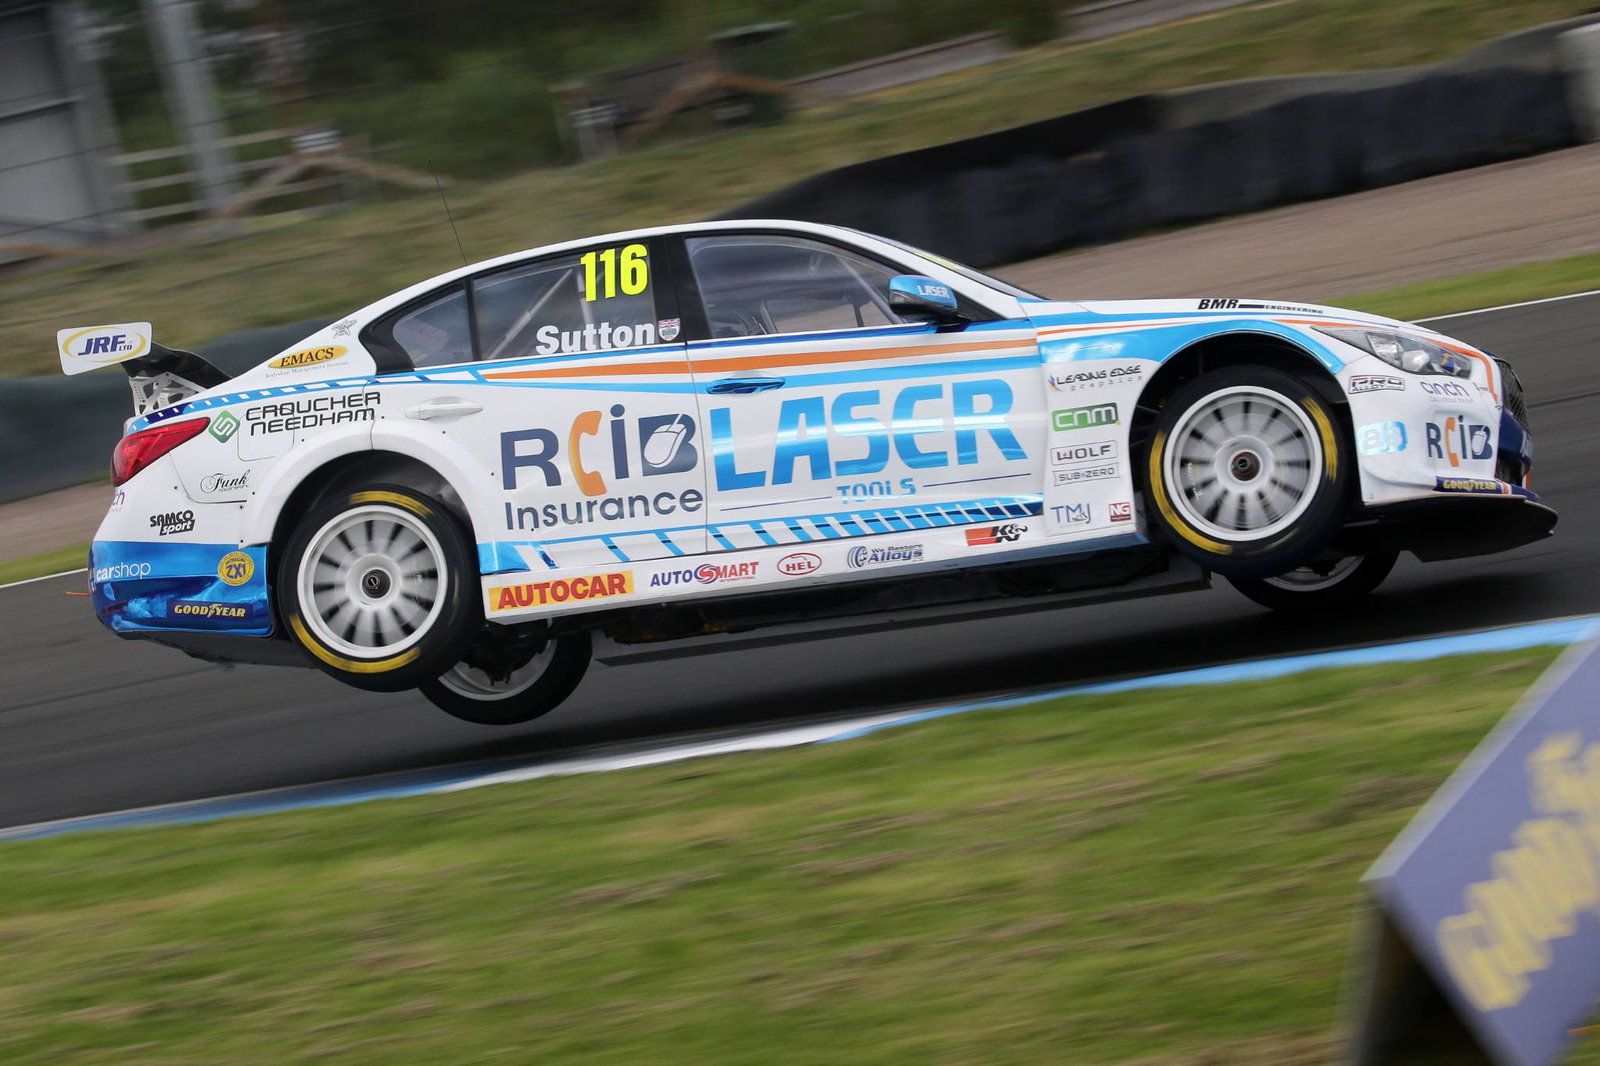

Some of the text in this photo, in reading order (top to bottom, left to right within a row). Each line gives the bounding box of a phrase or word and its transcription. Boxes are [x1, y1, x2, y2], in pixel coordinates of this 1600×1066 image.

[580, 243, 649, 302] 116
[916, 285, 951, 299] LASER
[1198, 299, 1324, 314] BMR ENGINEERING
[78, 334, 126, 356] JRF
[535, 322, 656, 356] Sutton
[279, 347, 335, 367] EMACS
[1056, 364, 1142, 384] LEADING EDGE
[1420, 381, 1471, 397] cinch
[246, 391, 381, 422] CROUCHER
[250, 408, 376, 436] NEEDHAM
[709, 378, 1029, 492] LASER
[1056, 445, 1111, 461] WOLF
[200, 469, 251, 494] Funk
[837, 478, 916, 505] TOOLS
[1443, 480, 1497, 491] GOODYEAR
[150, 510, 194, 527] SAMCO
[504, 489, 704, 531] Insurance
[1050, 503, 1092, 524] TMJ
[1111, 503, 1130, 516] NG
[161, 520, 193, 535] sport
[990, 523, 1029, 543] K&N
[867, 549, 924, 563] Alloys
[887, 543, 924, 552] Restore
[96, 562, 151, 581] carshop
[785, 560, 816, 572] HEL
[497, 573, 627, 610] AUTOCAR
[173, 603, 246, 618] GOODYEAR
